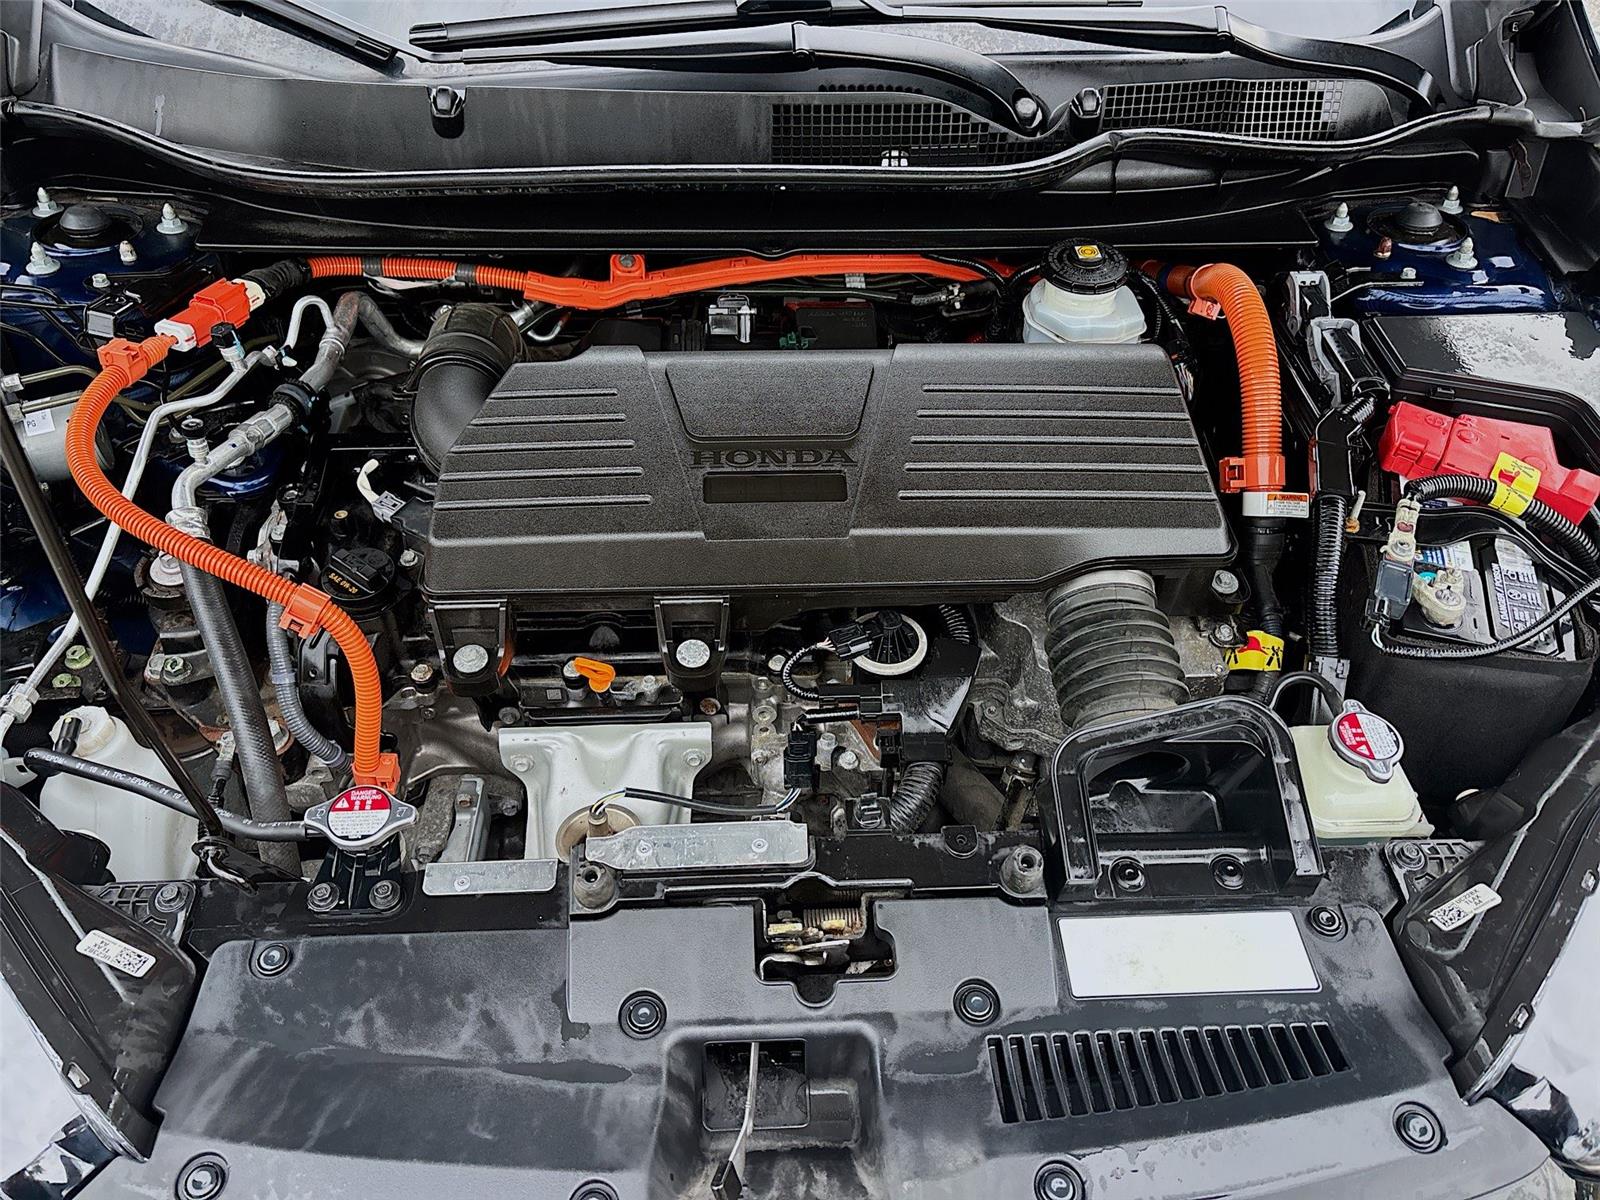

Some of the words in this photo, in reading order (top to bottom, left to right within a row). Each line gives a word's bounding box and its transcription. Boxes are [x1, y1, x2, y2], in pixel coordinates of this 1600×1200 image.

[690, 449, 858, 468] HONDA
[328, 572, 342, 583] SAE
[112, 770, 127, 781] TPC
